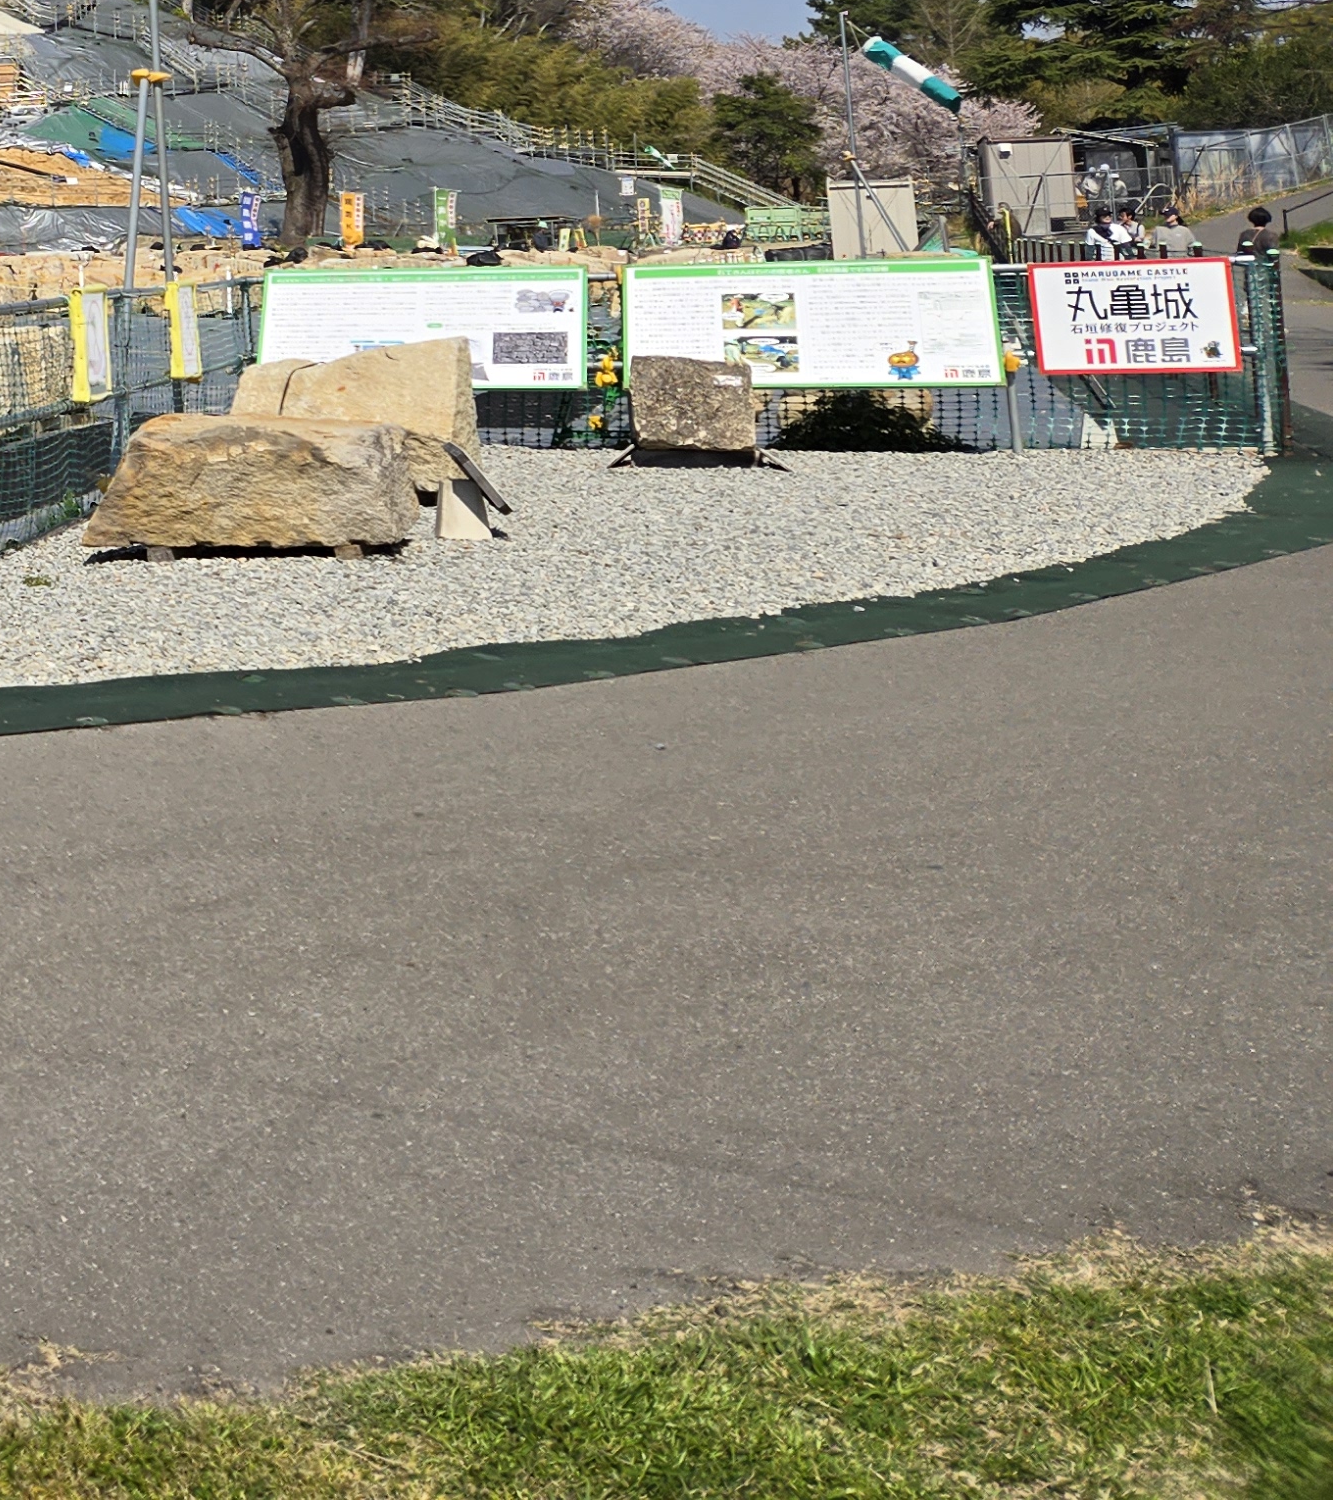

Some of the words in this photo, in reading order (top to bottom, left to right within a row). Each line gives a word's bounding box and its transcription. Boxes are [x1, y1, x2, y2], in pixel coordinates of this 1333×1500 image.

[1081, 270, 1142, 278] MARUGAME
[1066, 283, 1198, 321] 丸亀城
[1070, 321, 1199, 334] 石垣修復プロジェクト
[1125, 337, 1191, 363] 鹿島
